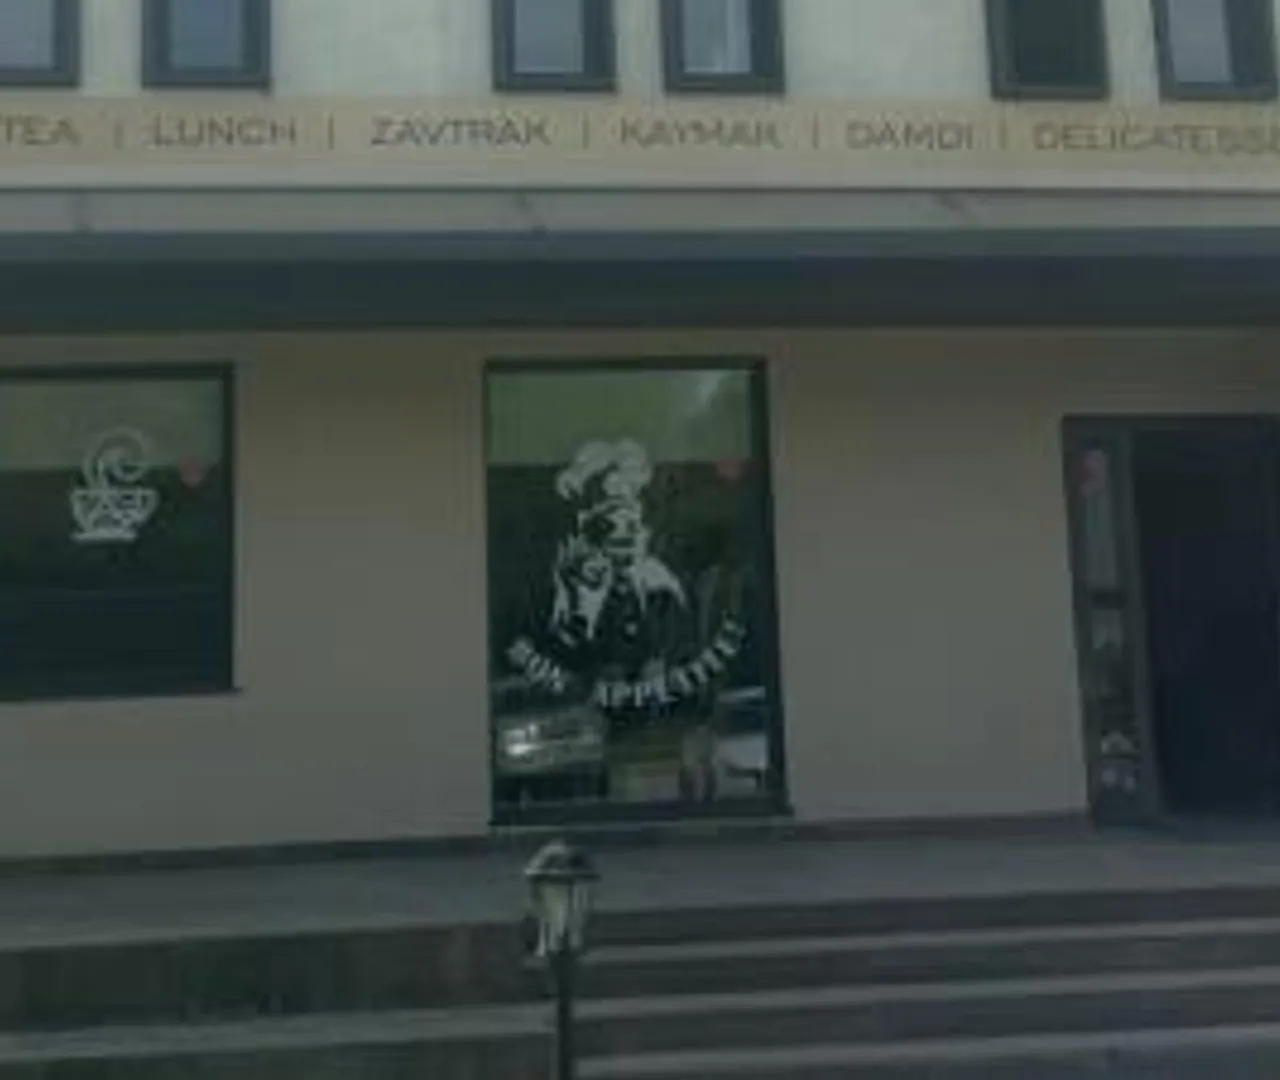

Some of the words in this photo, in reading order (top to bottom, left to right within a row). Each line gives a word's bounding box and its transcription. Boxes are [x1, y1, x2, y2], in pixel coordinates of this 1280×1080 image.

[0, 113, 82, 147] TEA
[152, 114, 296, 148] LUNCH
[370, 115, 553, 149] ZAVTRAK
[619, 115, 783, 150] KAYMAK
[846, 118, 976, 152] DAMDI
